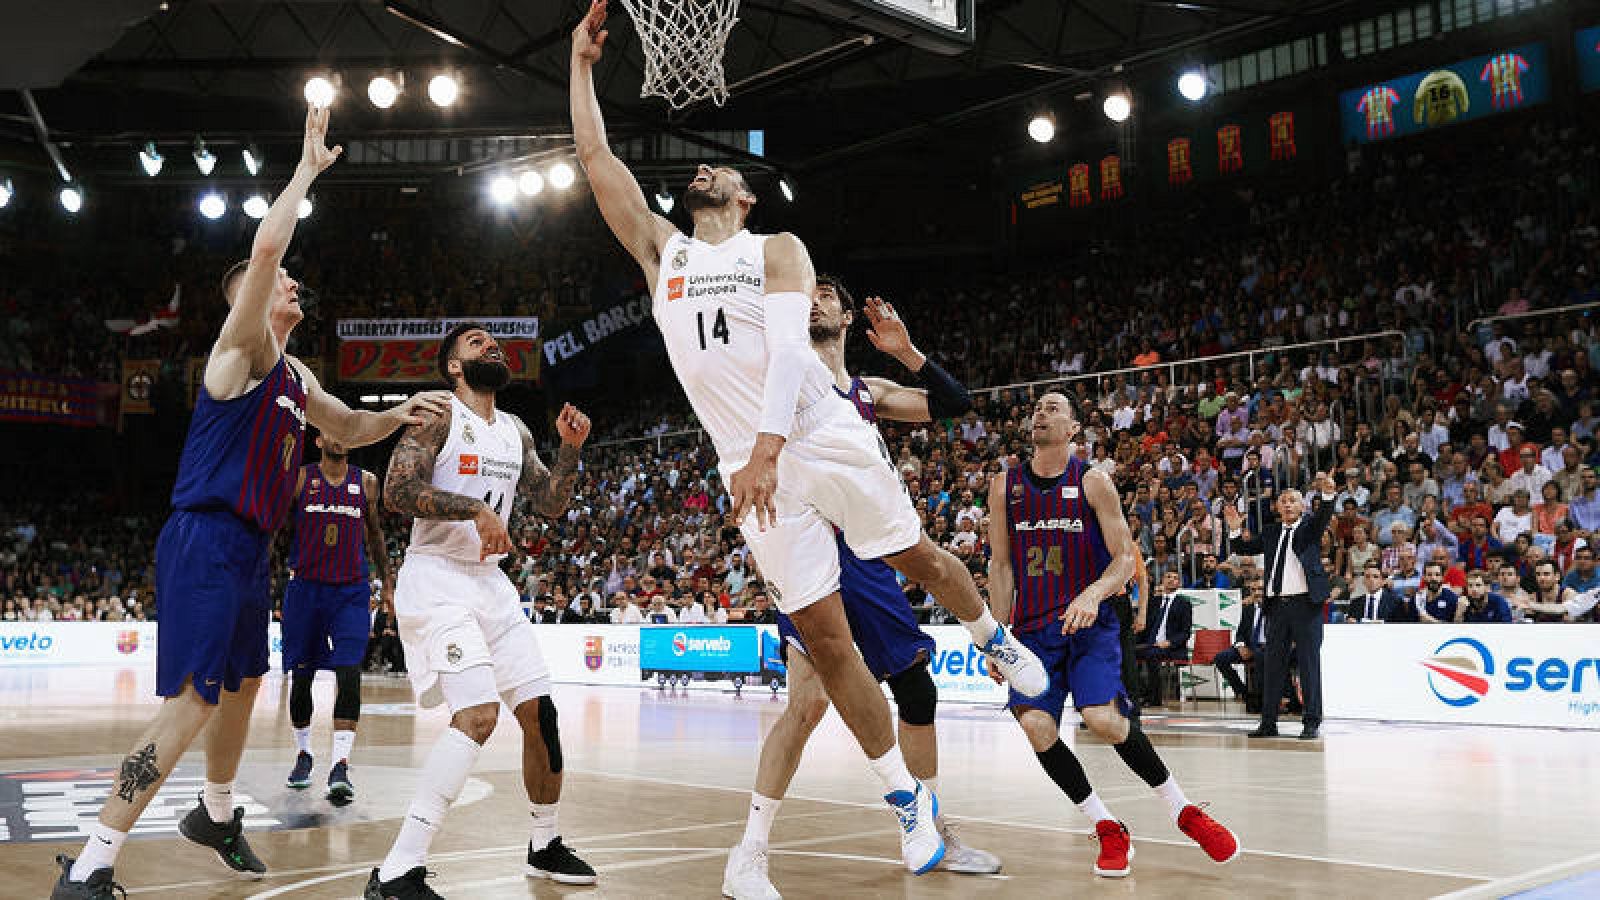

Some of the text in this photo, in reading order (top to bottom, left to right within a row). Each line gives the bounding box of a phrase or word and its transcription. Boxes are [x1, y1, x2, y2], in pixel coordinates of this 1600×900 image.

[687, 284, 737, 298] Europea
[689, 273, 761, 287] Universidad
[696, 307, 731, 350] 14
[543, 330, 584, 366] PEL
[1027, 546, 1064, 577] 24
[0, 632, 53, 651] veto
